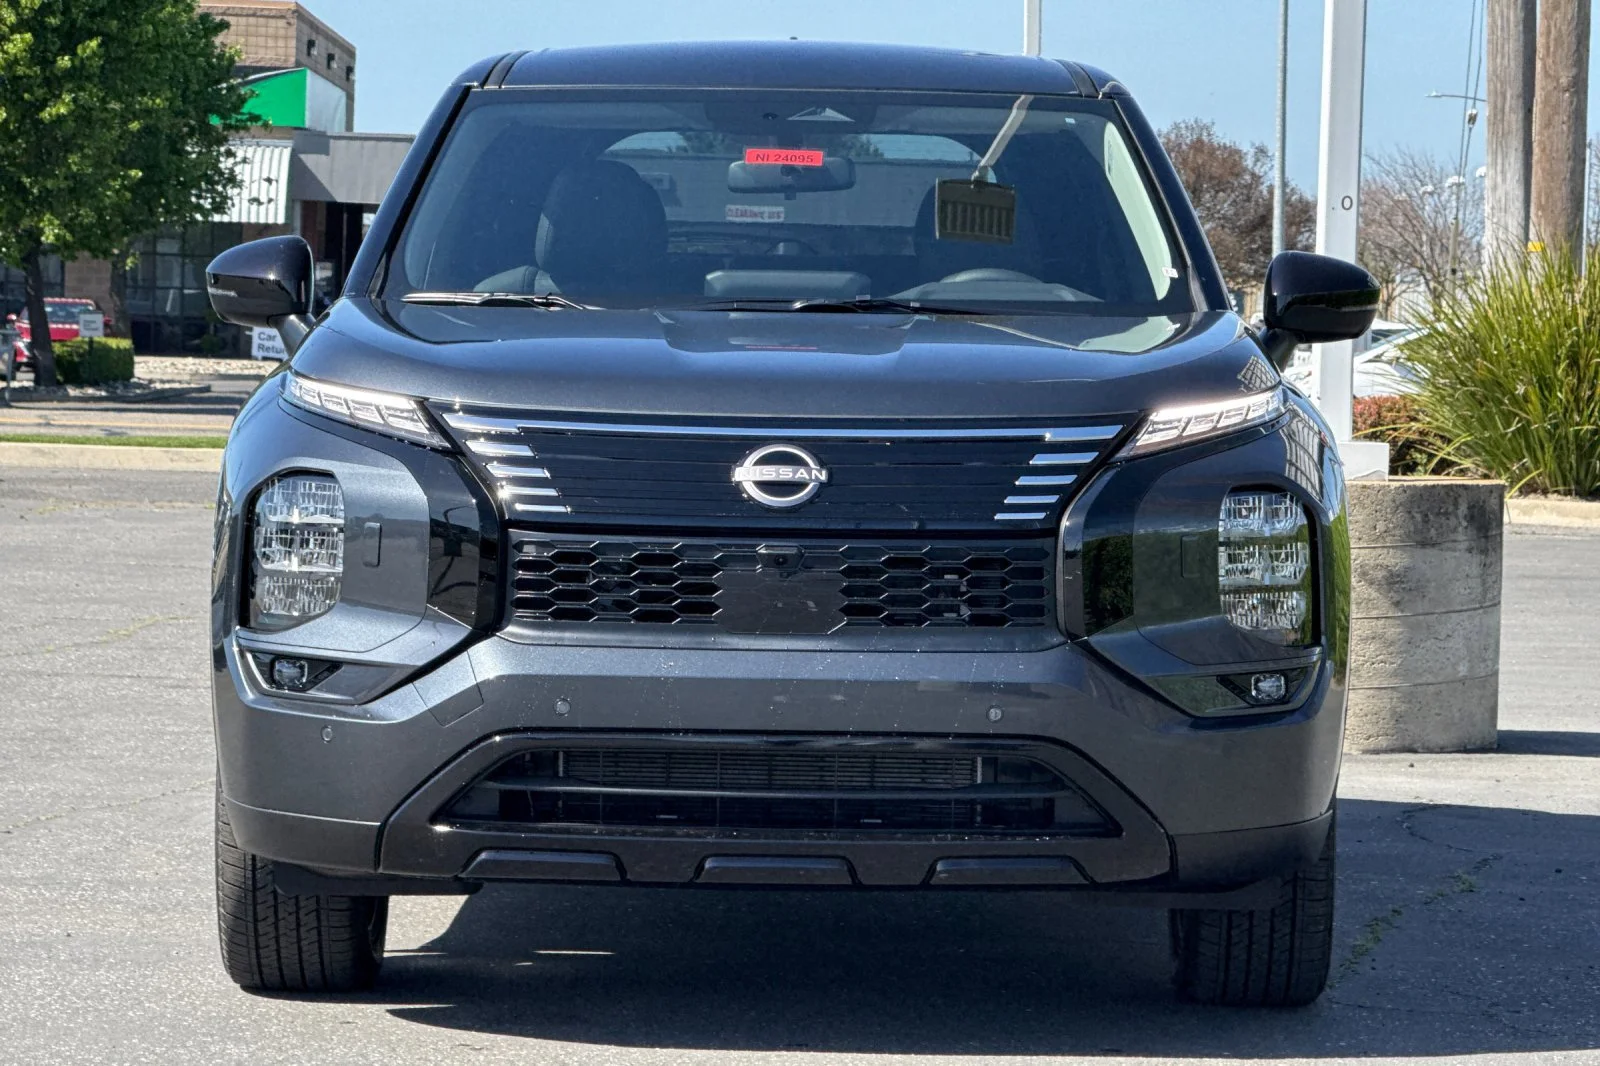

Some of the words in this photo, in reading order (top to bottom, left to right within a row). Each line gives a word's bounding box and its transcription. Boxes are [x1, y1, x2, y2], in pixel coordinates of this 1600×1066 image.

[774, 154, 814, 163] 24095
[257, 331, 277, 342] Car
[737, 467, 826, 480] NISSAN
